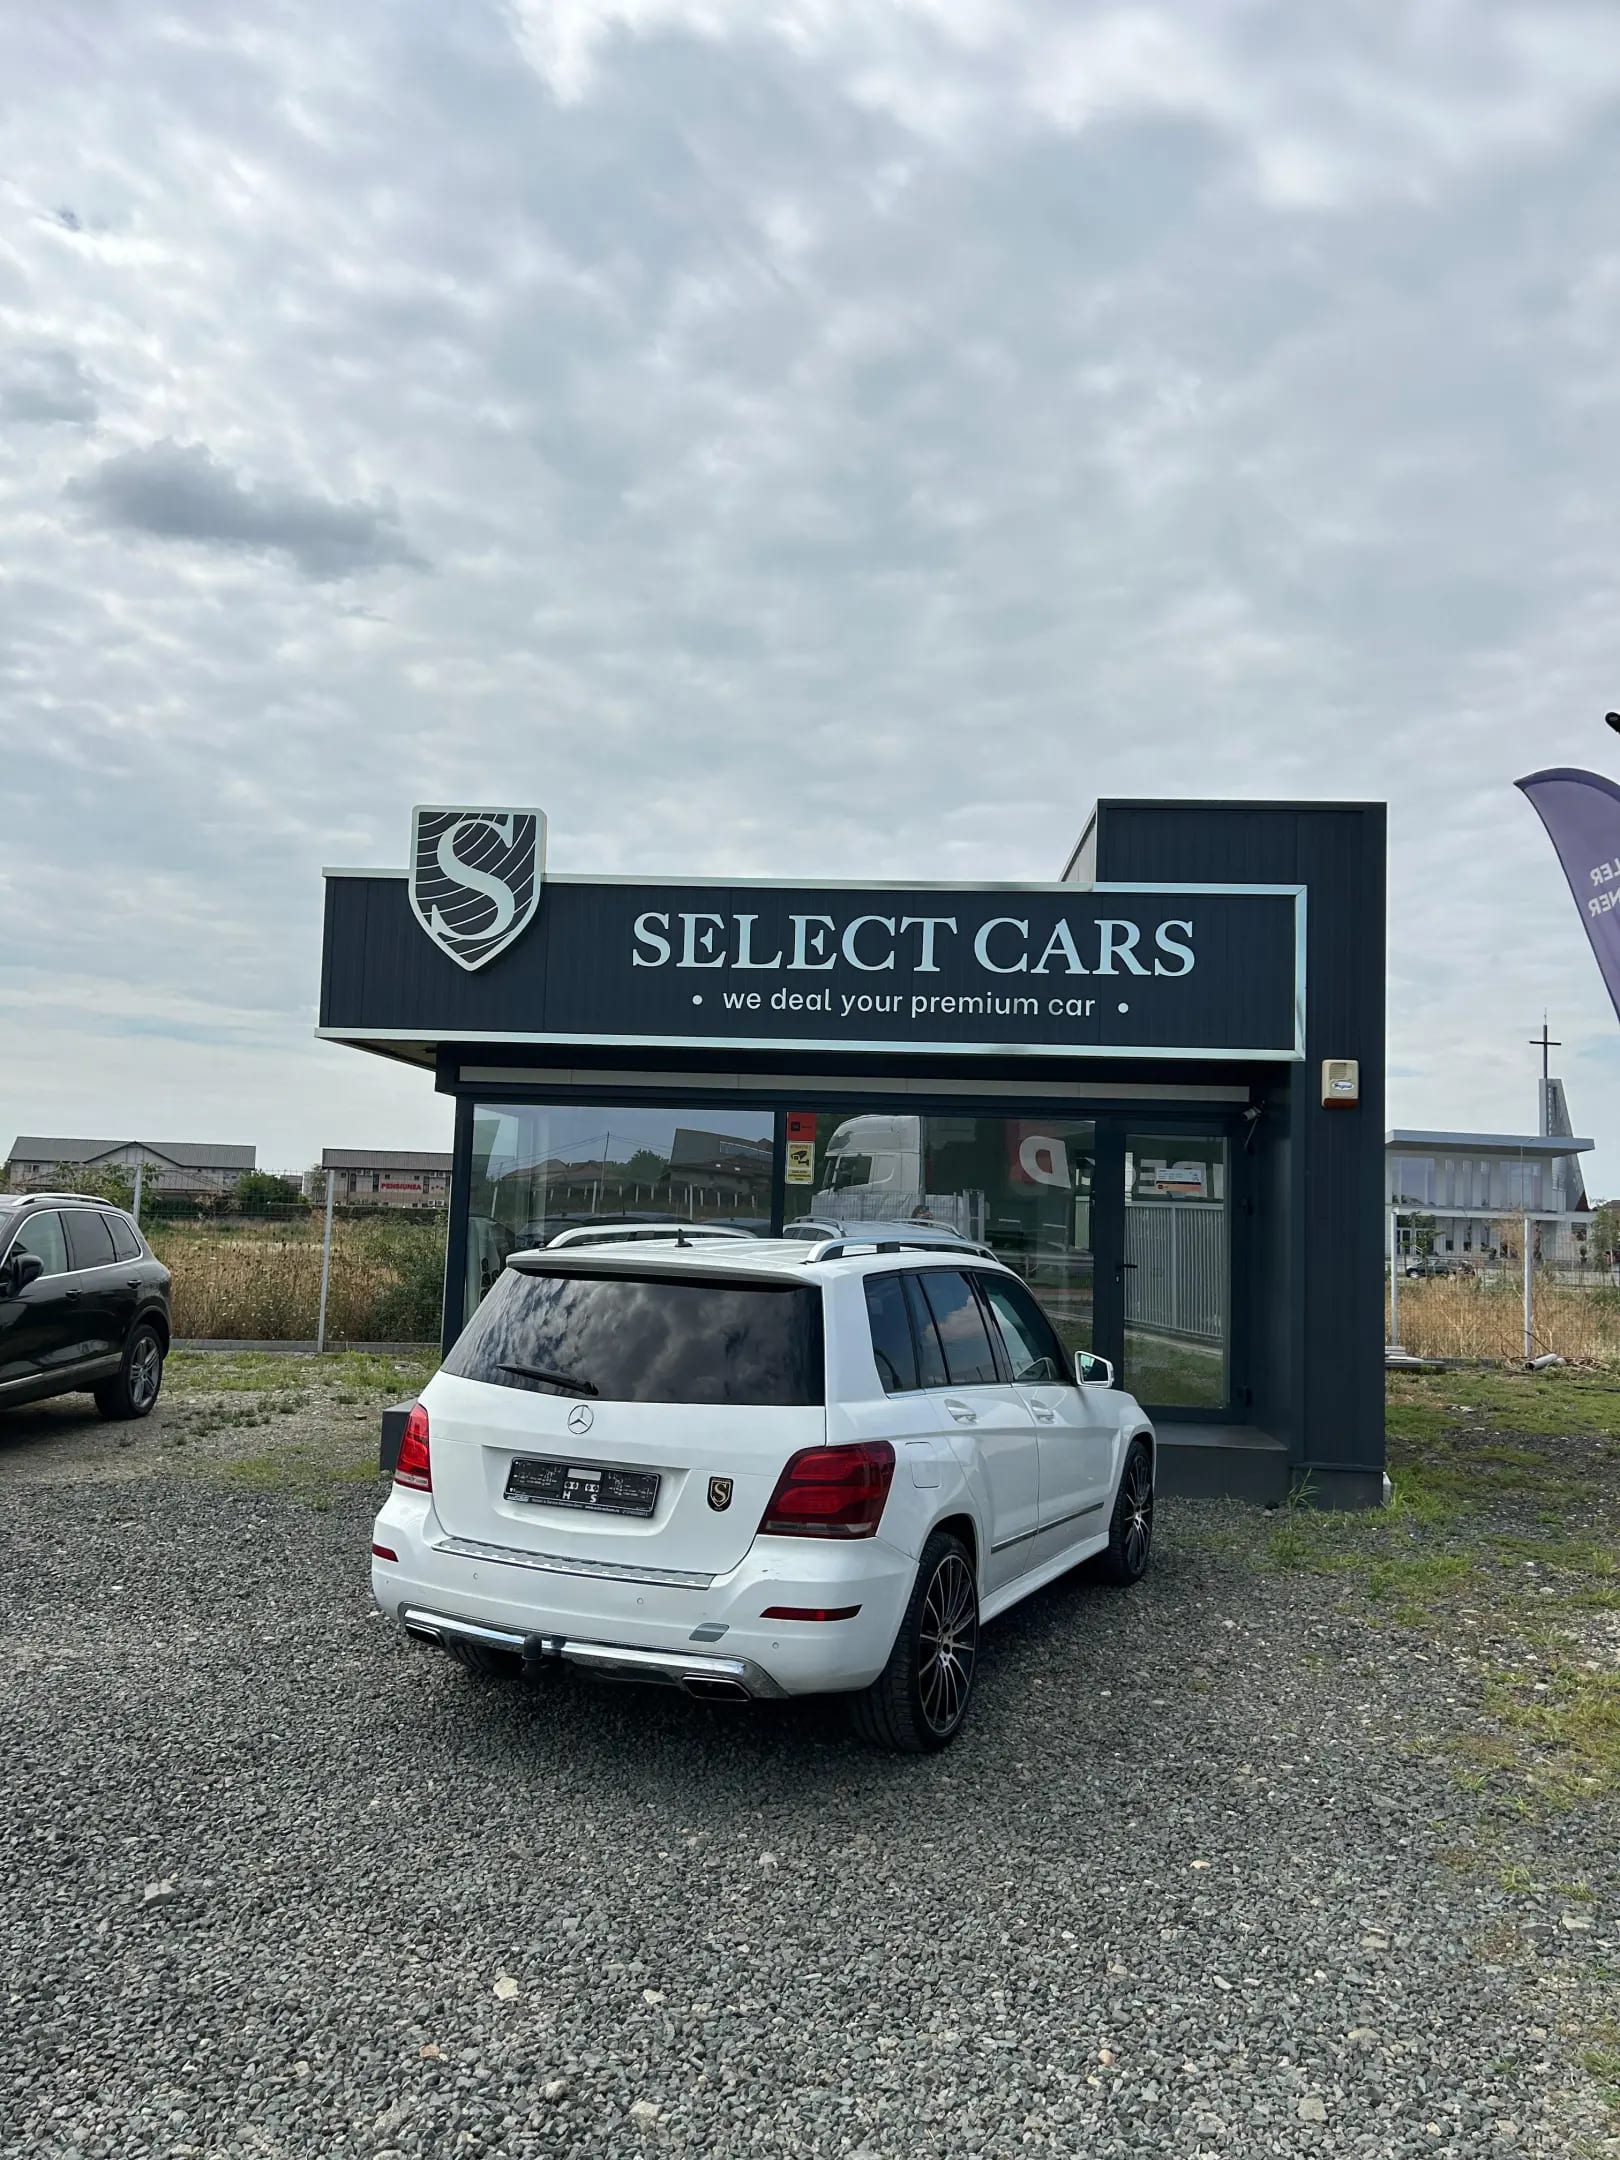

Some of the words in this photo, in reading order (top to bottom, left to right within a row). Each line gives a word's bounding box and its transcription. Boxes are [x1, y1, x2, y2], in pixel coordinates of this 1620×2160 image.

[431, 814, 516, 941] S
[632, 911, 958, 971] SELECT
[974, 917, 1196, 977] CARS
[723, 991, 762, 1010] we
[770, 987, 832, 1011] deal
[840, 993, 903, 1017] your
[911, 991, 1039, 1019] premium
[1048, 998, 1096, 1017] car
